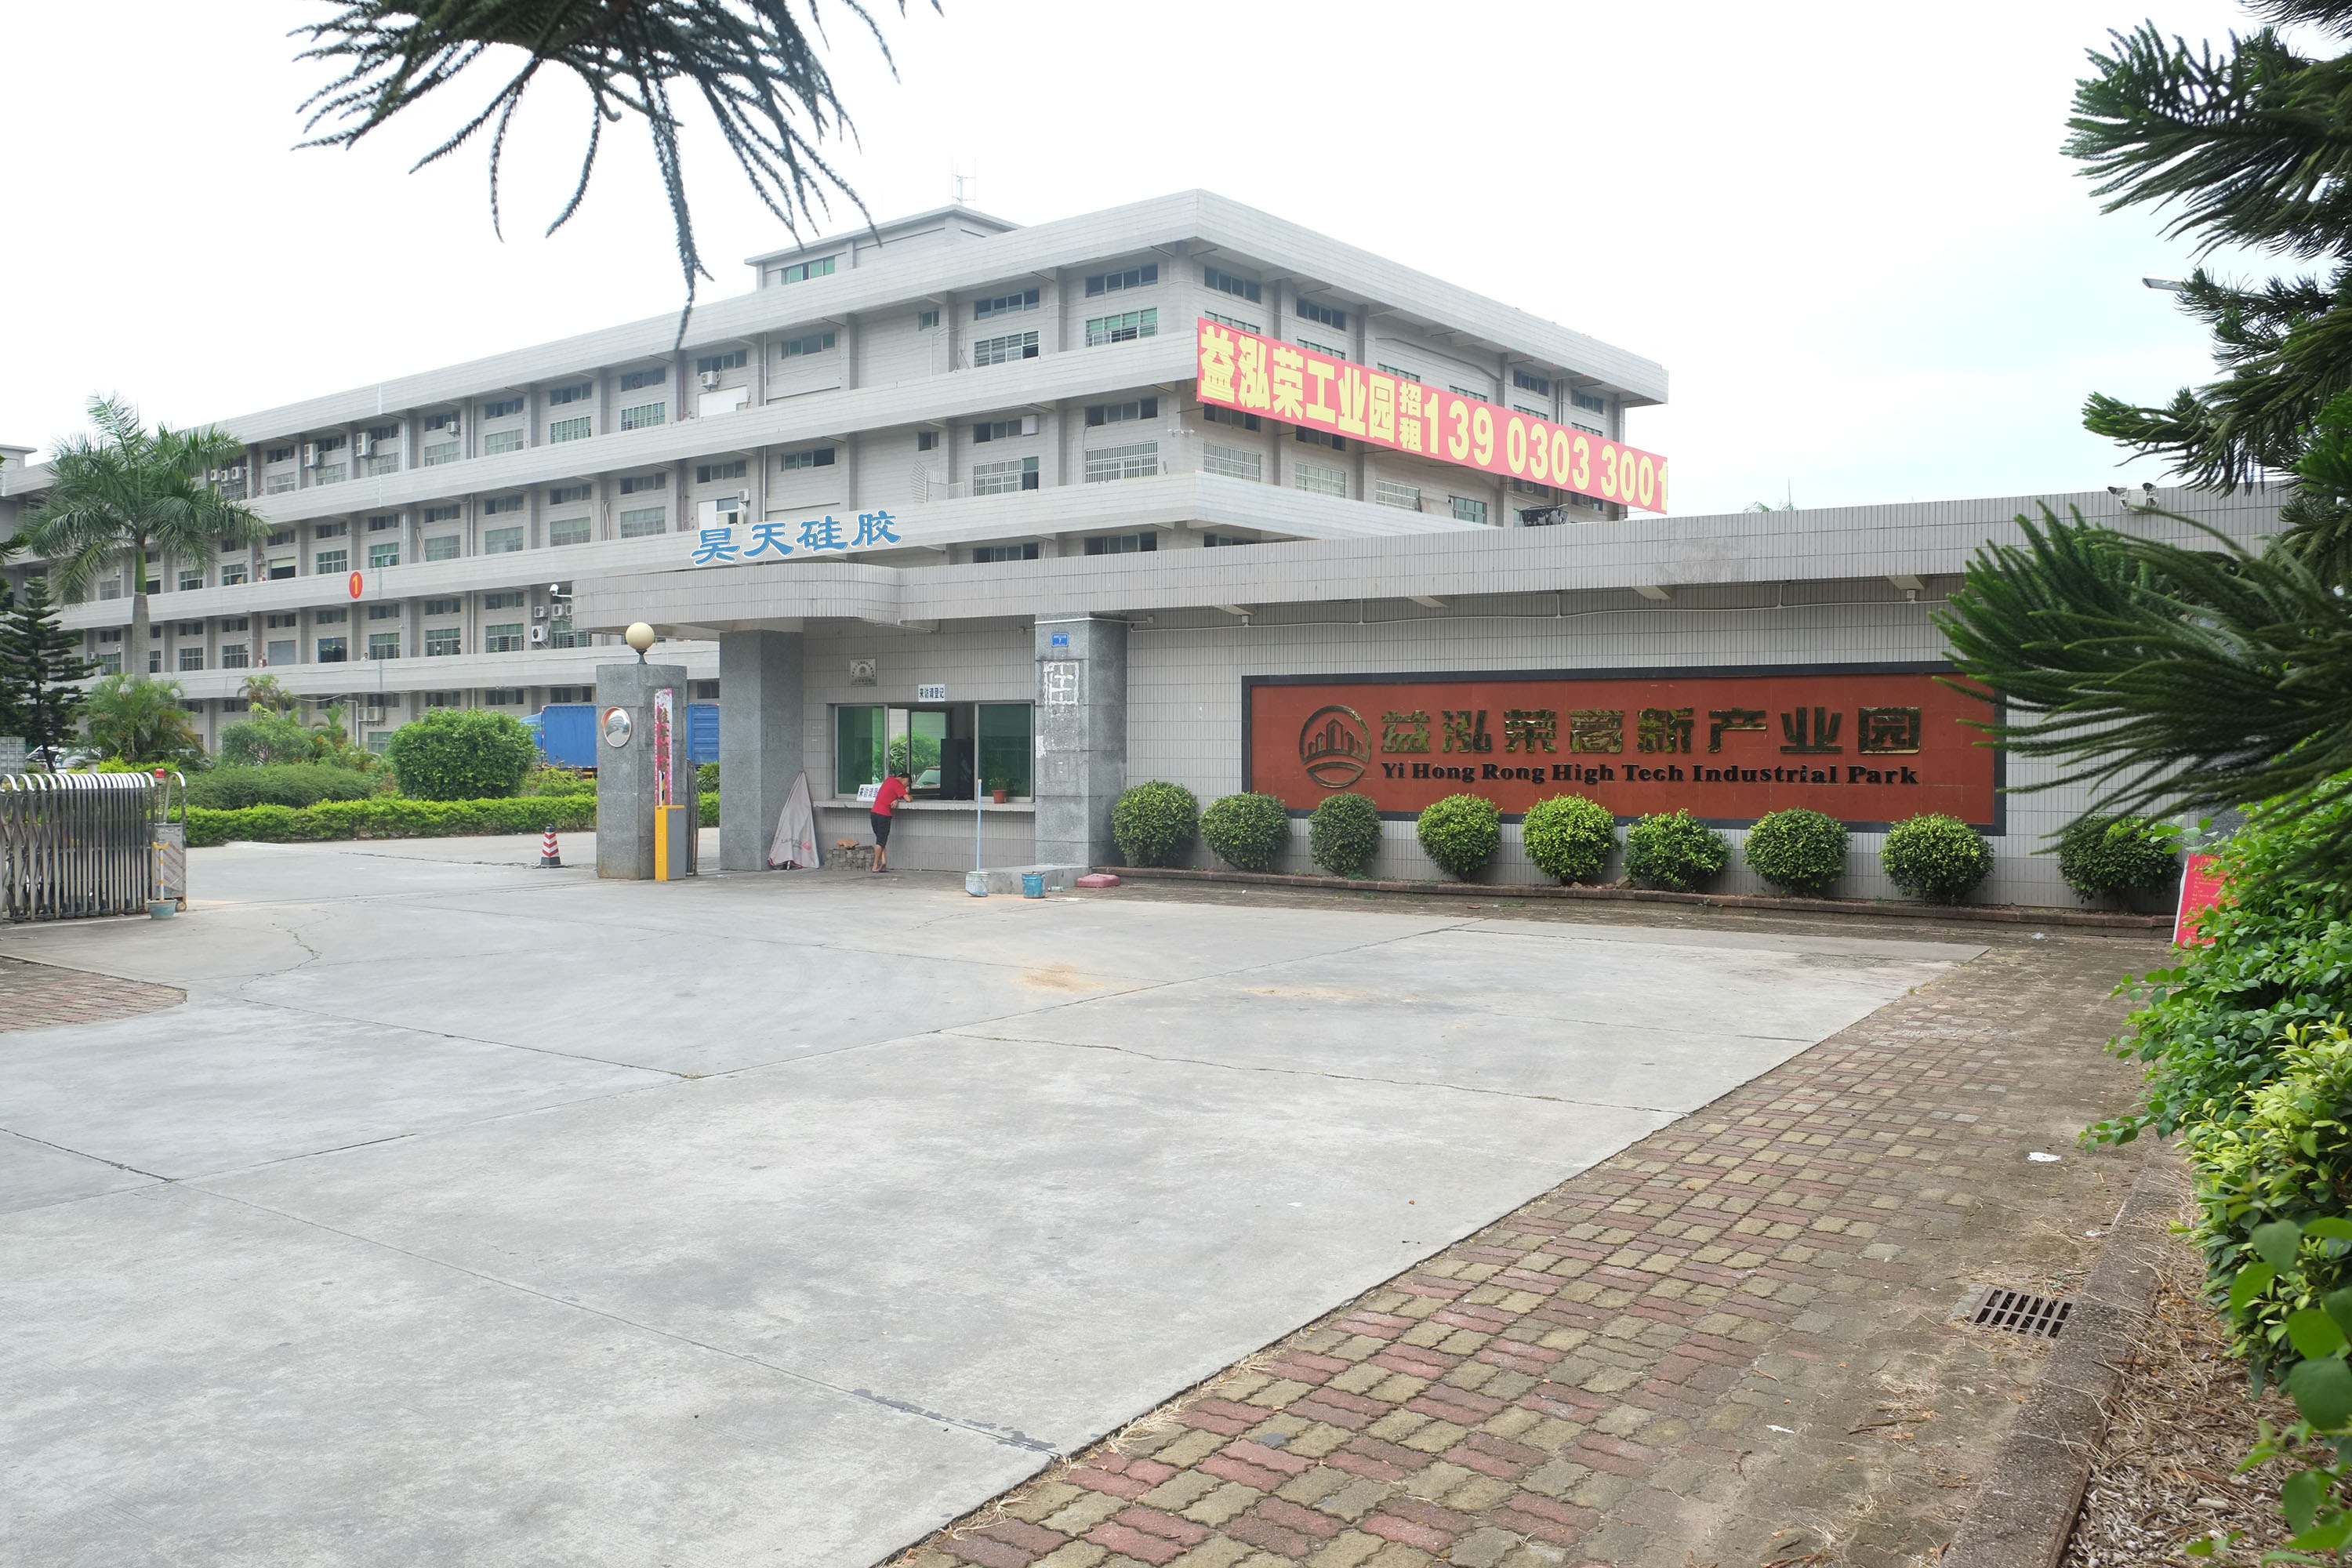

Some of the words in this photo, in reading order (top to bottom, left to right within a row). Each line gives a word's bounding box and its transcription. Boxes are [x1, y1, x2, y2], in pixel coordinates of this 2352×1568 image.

[1200, 325, 1395, 442] 益泓荣工业园
[1399, 381, 1422, 452] 招租
[1424, 393, 1494, 466] 139
[1507, 417, 1589, 491] 0303
[1601, 445, 1668, 511] 3001
[691, 510, 902, 565] 昊天硅胶
[352, 575, 358, 595] 1
[919, 687, 945, 699] 来访请登记
[1381, 706, 1921, 755] 益泓荣高新产业园
[1381, 762, 1405, 779] Yi
[1411, 763, 1475, 783] Hong
[1481, 763, 1546, 783] Rong
[1552, 763, 1616, 784] High
[1621, 763, 1684, 782] Tech
[1692, 764, 1838, 784] Industrial
[1846, 765, 1919, 785] Park
